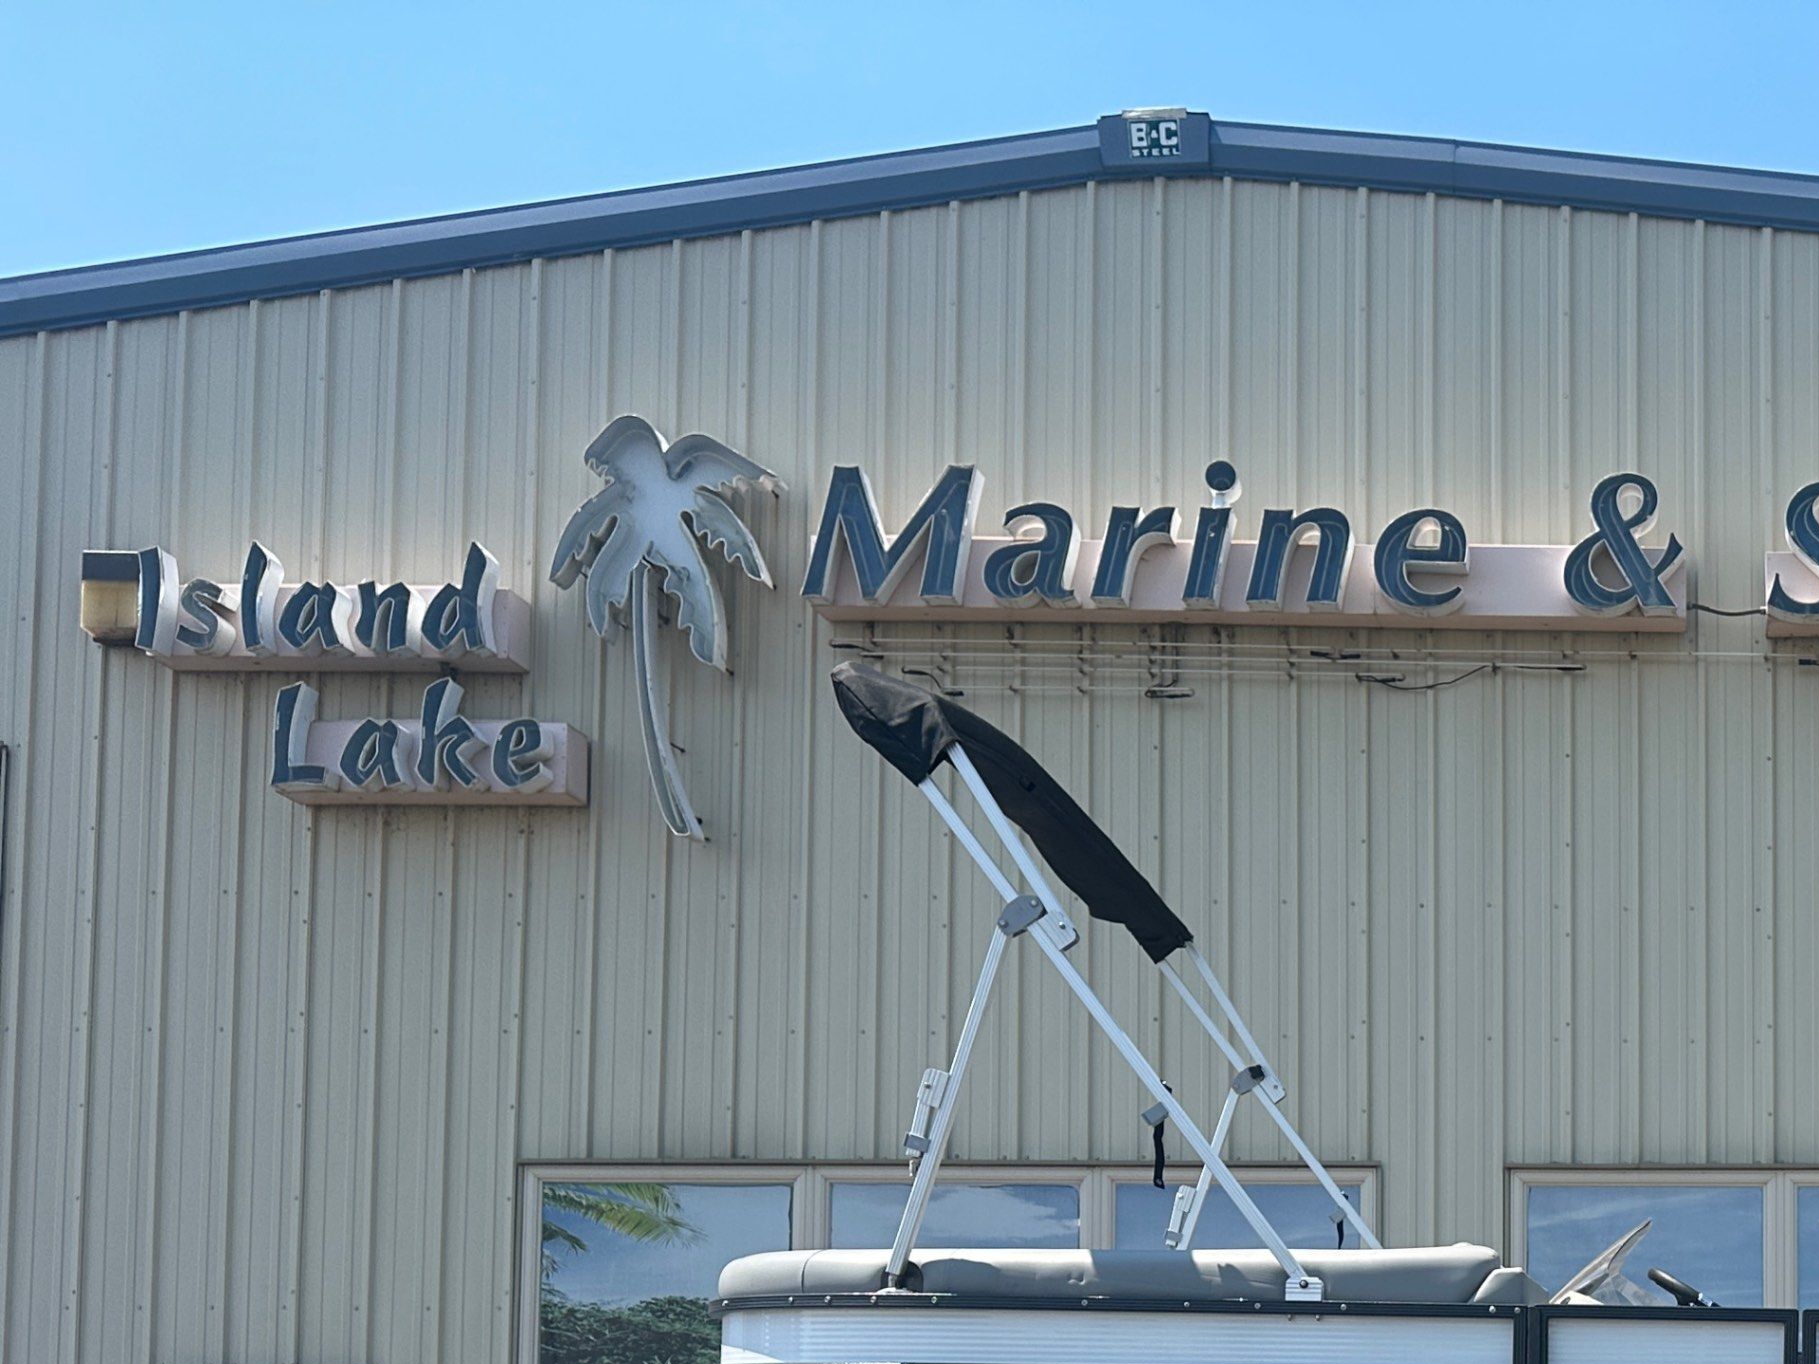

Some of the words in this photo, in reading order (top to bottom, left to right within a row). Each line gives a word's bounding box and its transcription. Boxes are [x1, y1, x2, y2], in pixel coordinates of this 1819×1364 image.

[1131, 148, 1180, 157] STEEL
[801, 460, 1470, 615] Marine
[1563, 473, 1685, 616] &
[134, 541, 500, 656] Island
[271, 677, 553, 792] Lake
